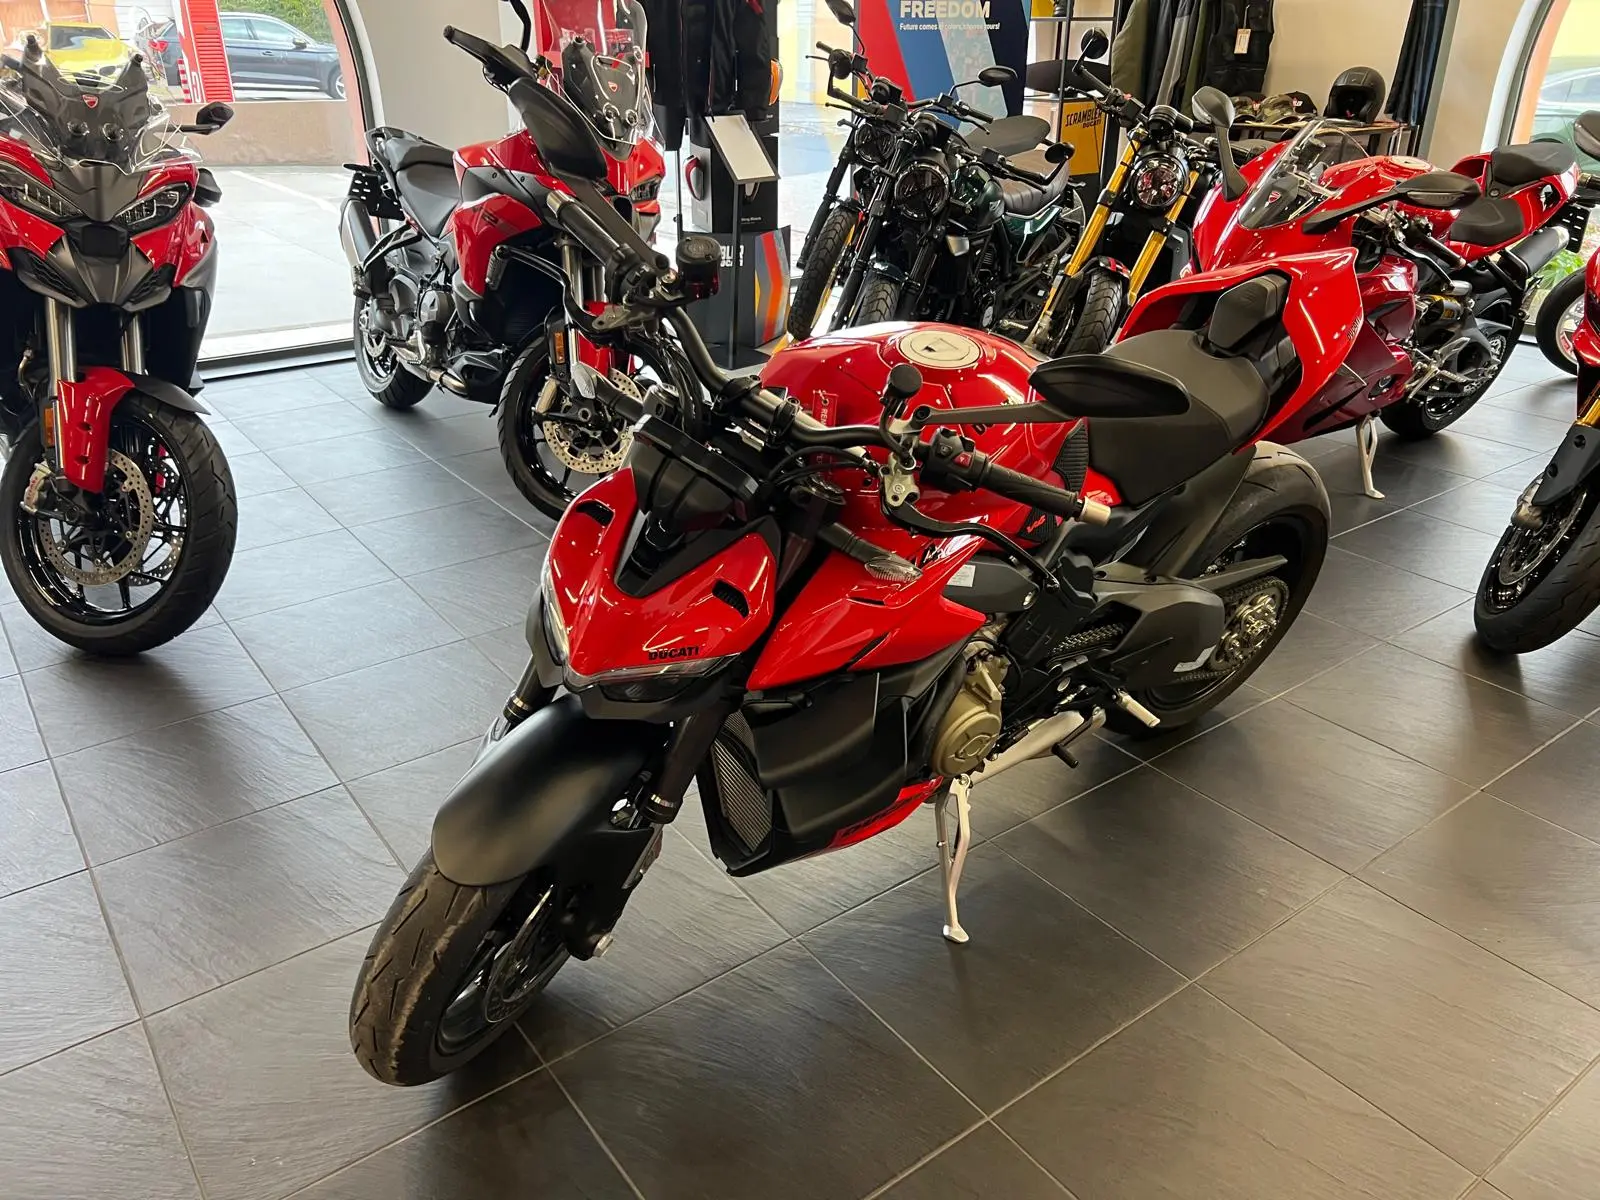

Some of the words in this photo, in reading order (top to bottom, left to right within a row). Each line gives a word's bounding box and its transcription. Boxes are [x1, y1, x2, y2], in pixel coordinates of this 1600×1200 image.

[900, 1, 991, 18] FREEDOM
[899, 22, 918, 31] Future
[919, 23, 938, 31] comes
[648, 645, 699, 660] DUCATI
